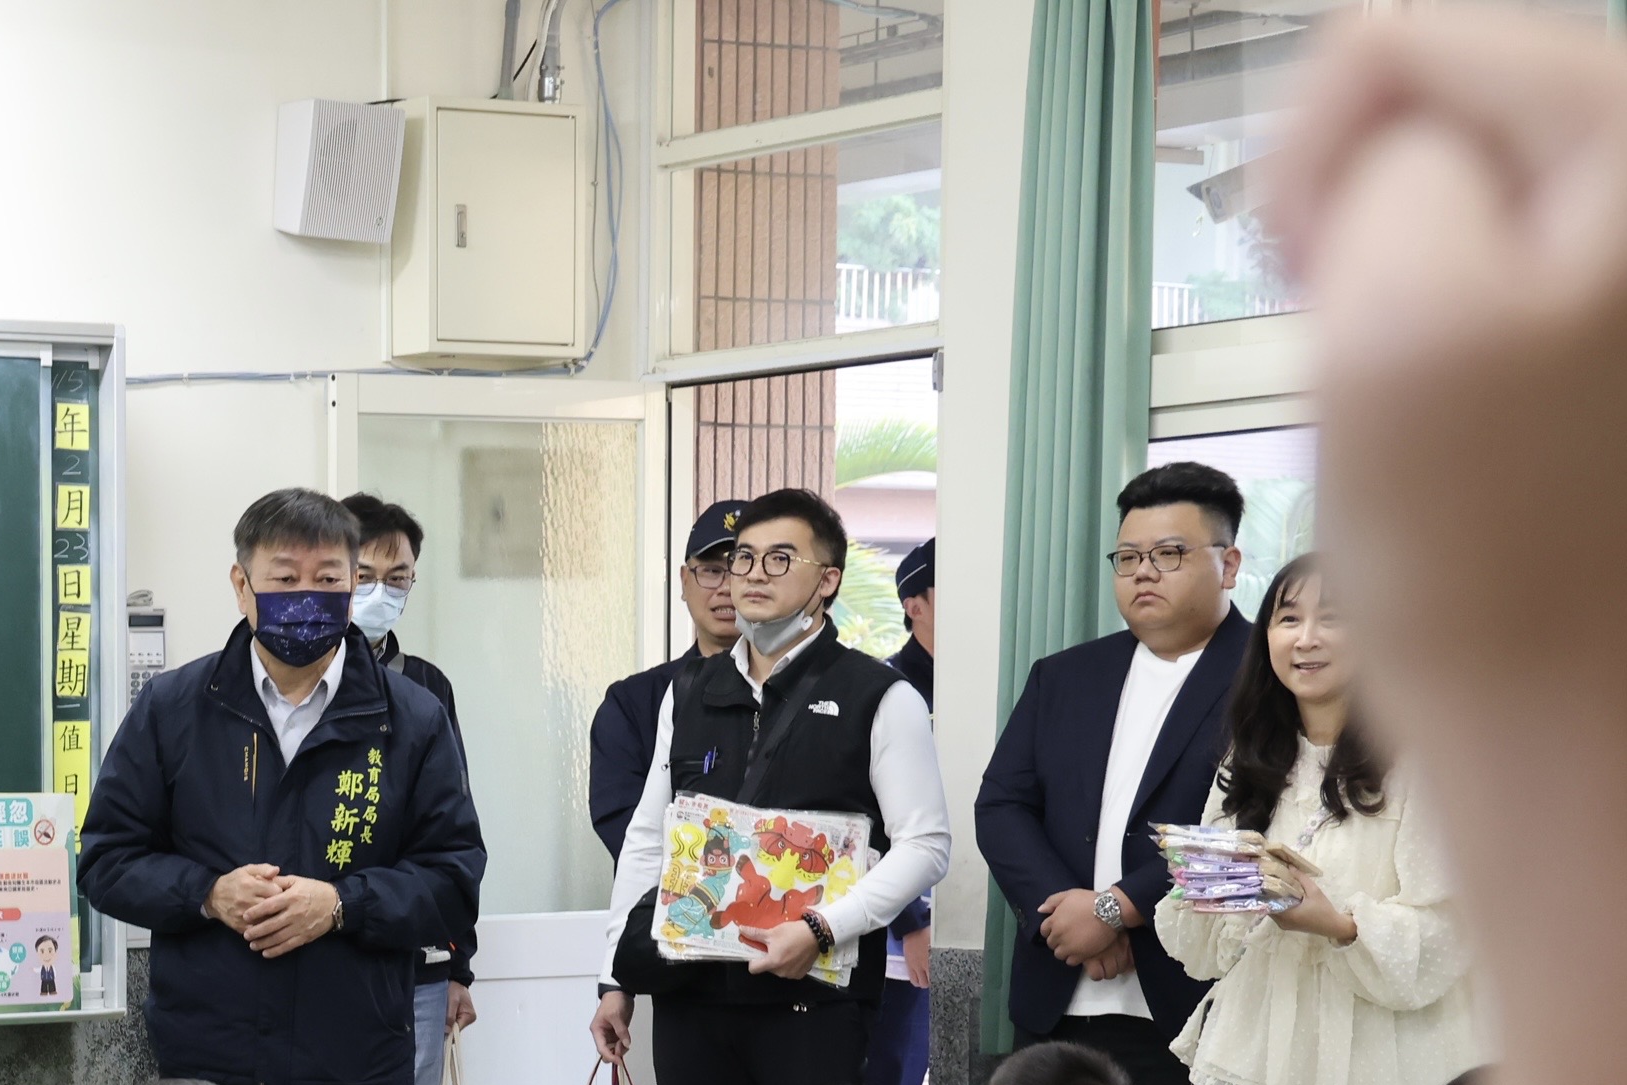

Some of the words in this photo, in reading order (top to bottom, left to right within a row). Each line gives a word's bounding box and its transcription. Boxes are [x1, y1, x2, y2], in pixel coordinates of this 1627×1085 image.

[57, 406, 88, 447] 年
[62, 455, 82, 476] 2
[61, 490, 84, 526] 月
[54, 533, 89, 560] 23
[63, 569, 81, 599] 日
[359, 747, 383, 844] 教育局局長
[325, 770, 364, 871] 鄭新輝
